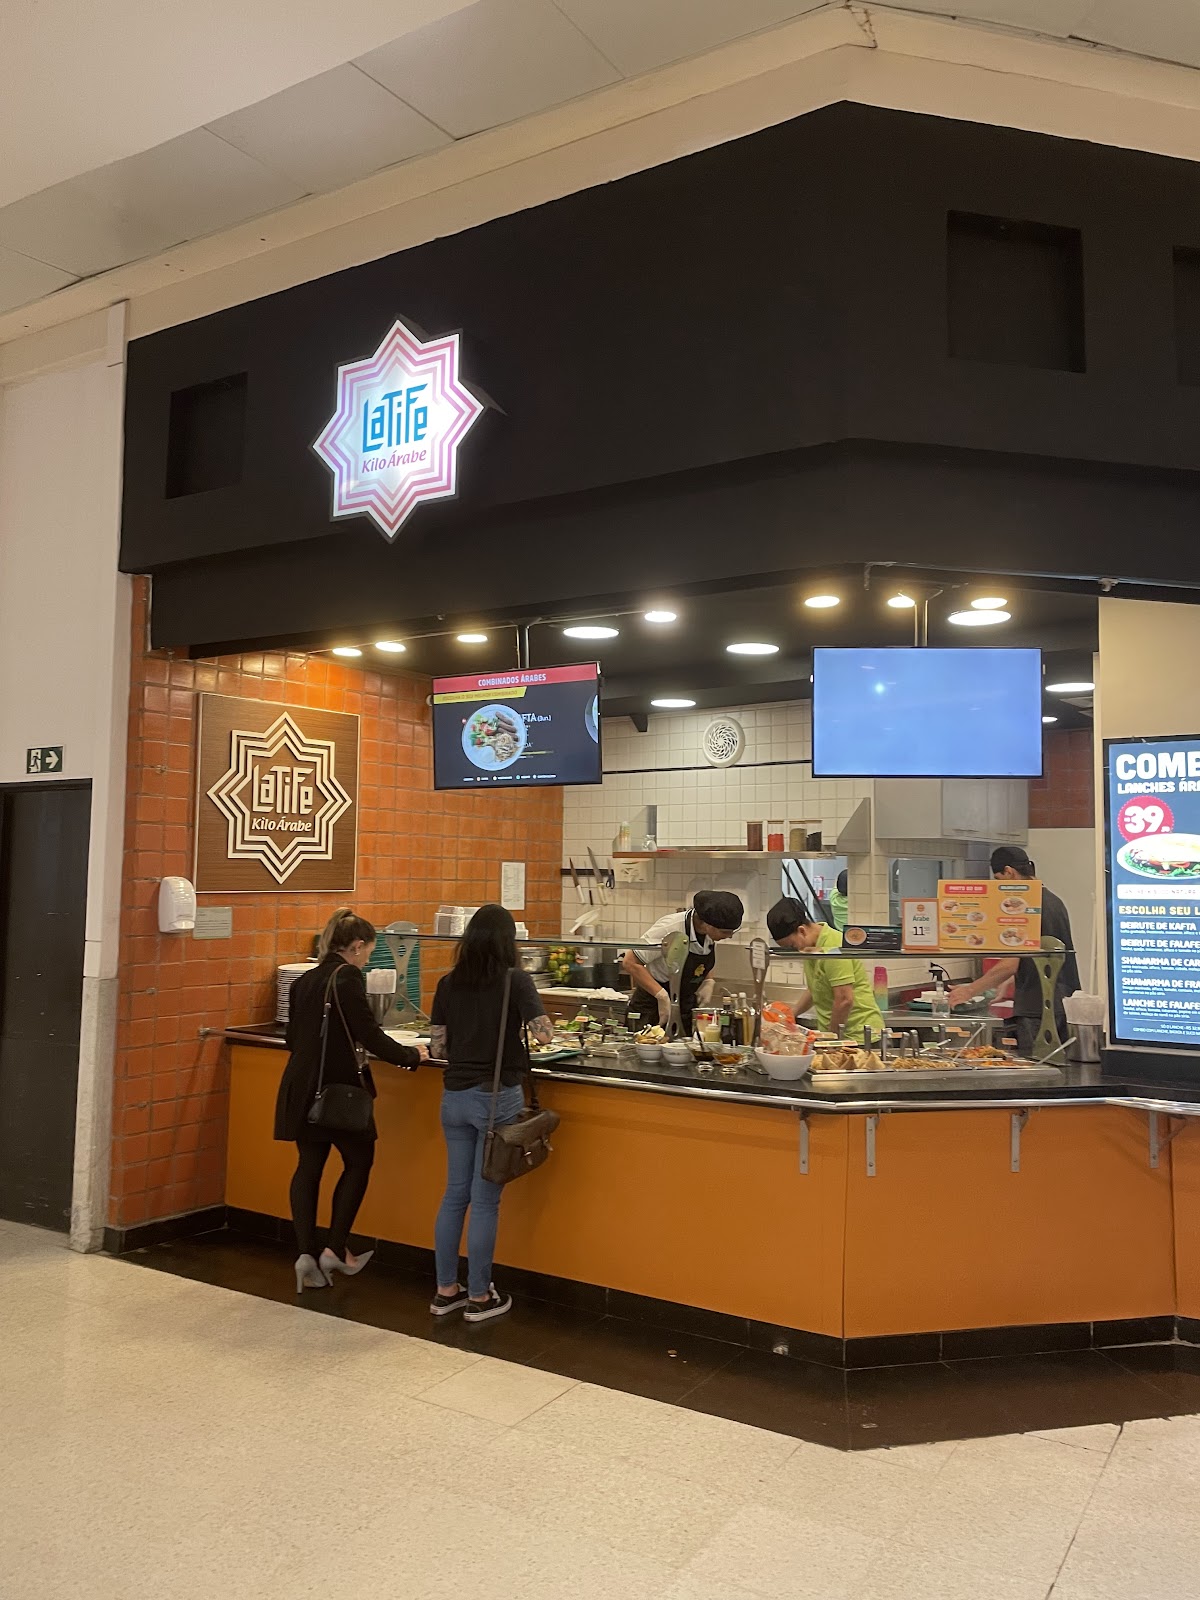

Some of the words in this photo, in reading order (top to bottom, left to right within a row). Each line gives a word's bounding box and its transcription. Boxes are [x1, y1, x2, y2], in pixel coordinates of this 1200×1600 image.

[362, 456, 386, 474] Kilo
[387, 449, 427, 469] Árabe
[478, 675, 519, 687] COMBINADOS
[520, 673, 546, 683] ÁRABES
[521, 713, 536, 723] FTA
[1117, 781, 1175, 794] LANCHES
[252, 817, 276, 831] Kilo
[276, 816, 312, 832] Árabe
[1118, 905, 1166, 915] ESCOLHA
[1169, 906, 1191, 916] SEU
[1120, 921, 1155, 930] BEIRUTE
[1156, 922, 1168, 931] DE
[1168, 922, 1197, 931] KAFTA
[1120, 938, 1156, 948] BEIRUTE
[1156, 939, 1169, 948] DE
[1121, 956, 1170, 966] SHAWARMA
[1171, 957, 1183, 967] DE
[1121, 977, 1171, 987] SHAWARMA
[1171, 978, 1184, 988] DE
[1122, 998, 1155, 1008] LANCHE
[1156, 1000, 1169, 1009] DE
